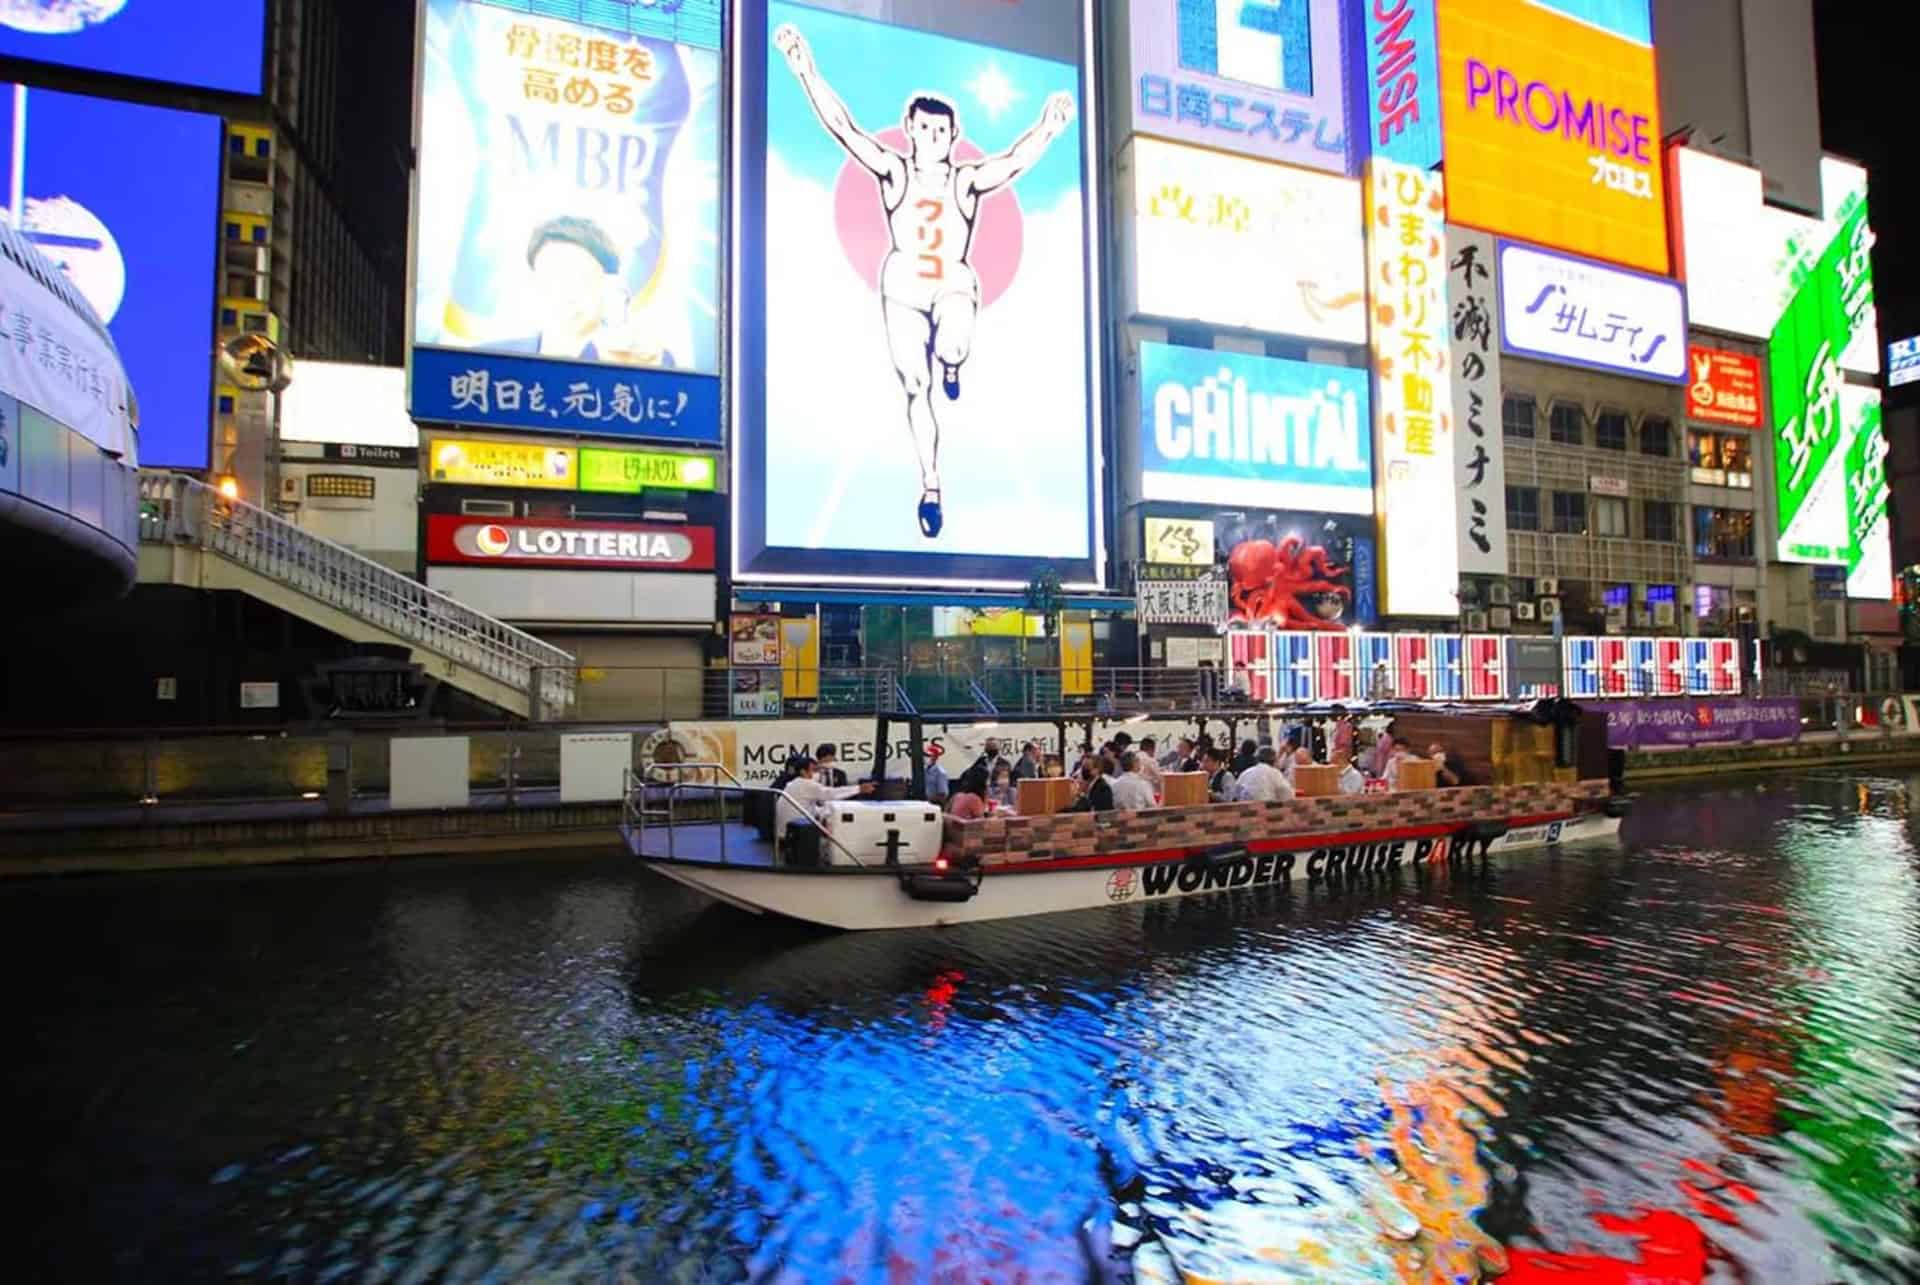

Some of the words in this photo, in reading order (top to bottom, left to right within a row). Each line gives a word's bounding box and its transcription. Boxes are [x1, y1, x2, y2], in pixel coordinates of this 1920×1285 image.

[522, 67, 635, 115] 高める
[1464, 57, 1652, 165] PROMISE
[359, 448, 401, 460] Toilets
[517, 530, 673, 557] LOTTERIA
[743, 743, 811, 766] MGM
[1141, 852, 1296, 897] WONDER
[1305, 839, 1405, 881] CRUISE
